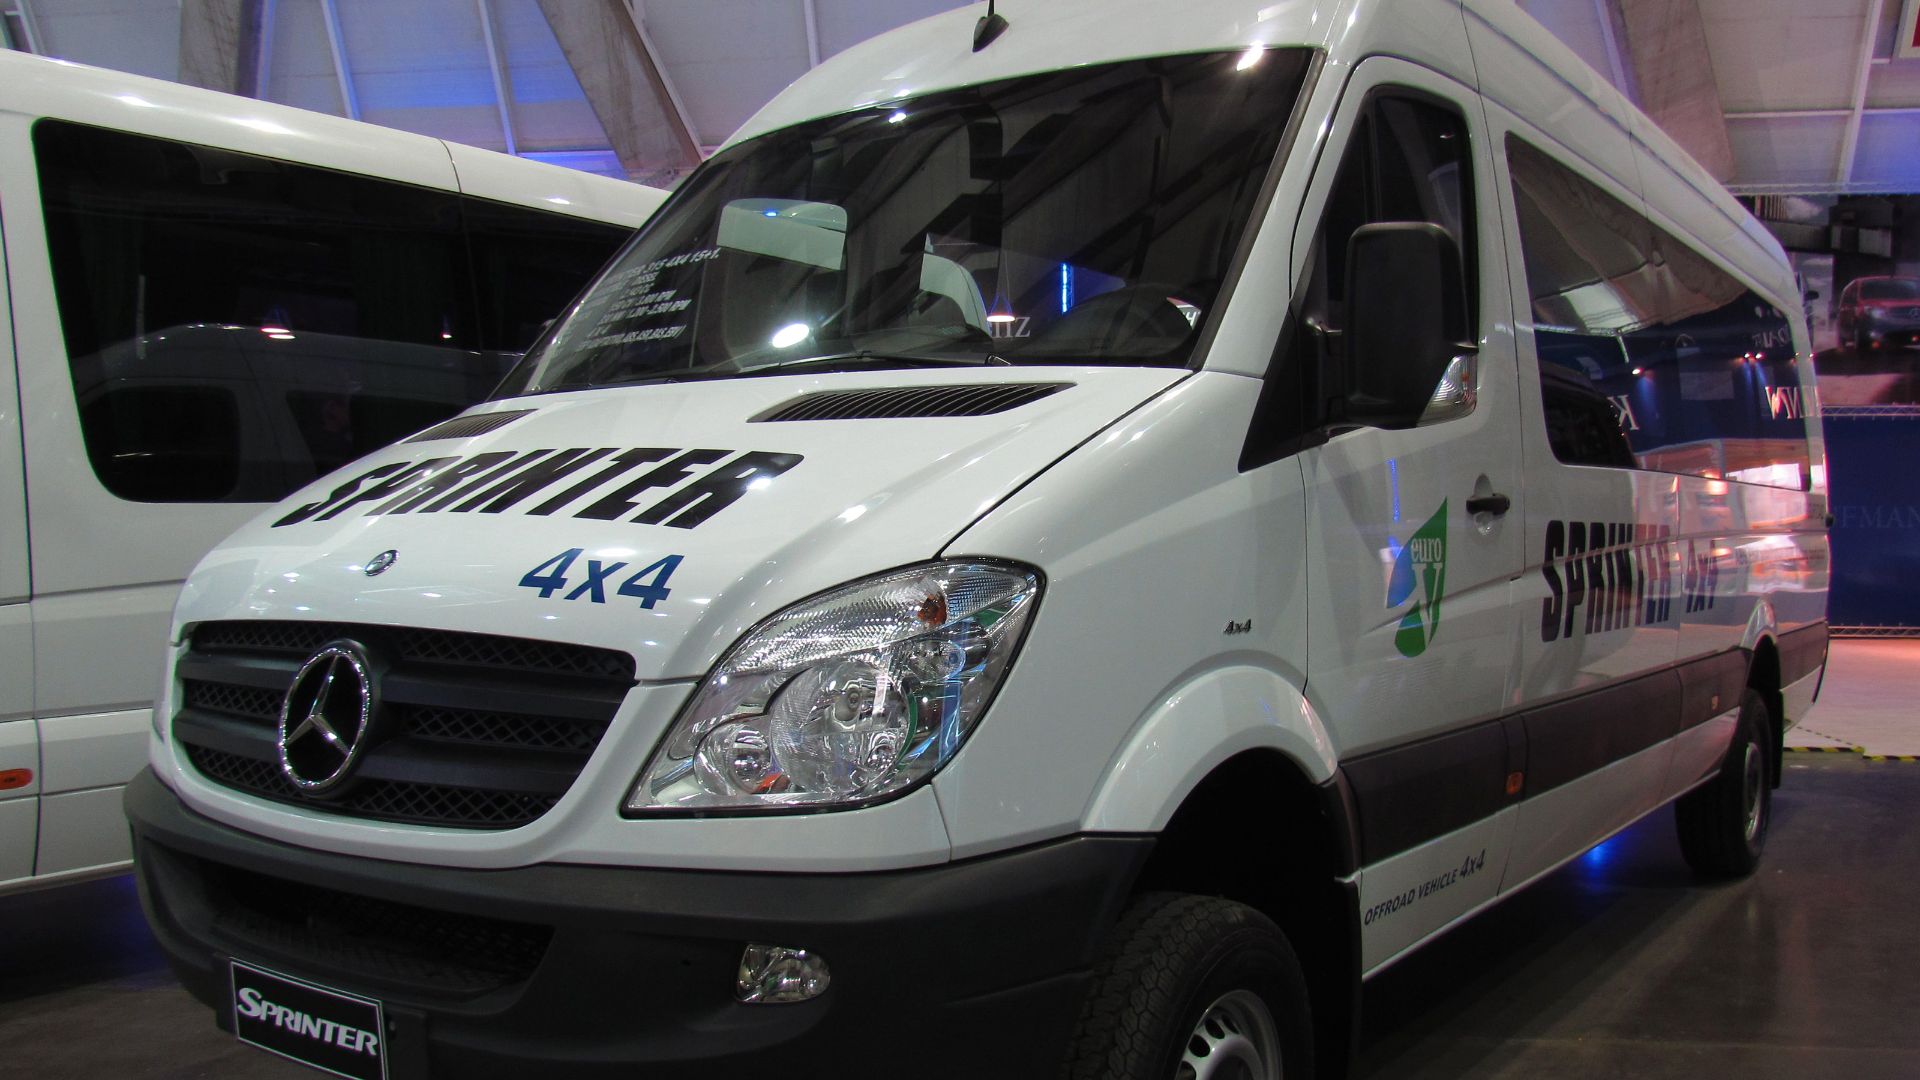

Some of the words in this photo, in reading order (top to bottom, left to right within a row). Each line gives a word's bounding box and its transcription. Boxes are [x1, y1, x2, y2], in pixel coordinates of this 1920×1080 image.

[271, 447, 805, 530] SPRINTER
[517, 547, 685, 611] 4x4
[1410, 537, 1443, 563] euro
[1541, 520, 1671, 643] SPRINTER
[1364, 888, 1416, 926] OFFROAD
[1417, 868, 1459, 899] VEHICLE
[1459, 848, 1486, 878] 4x4
[237, 987, 378, 1057] SPRINTER
